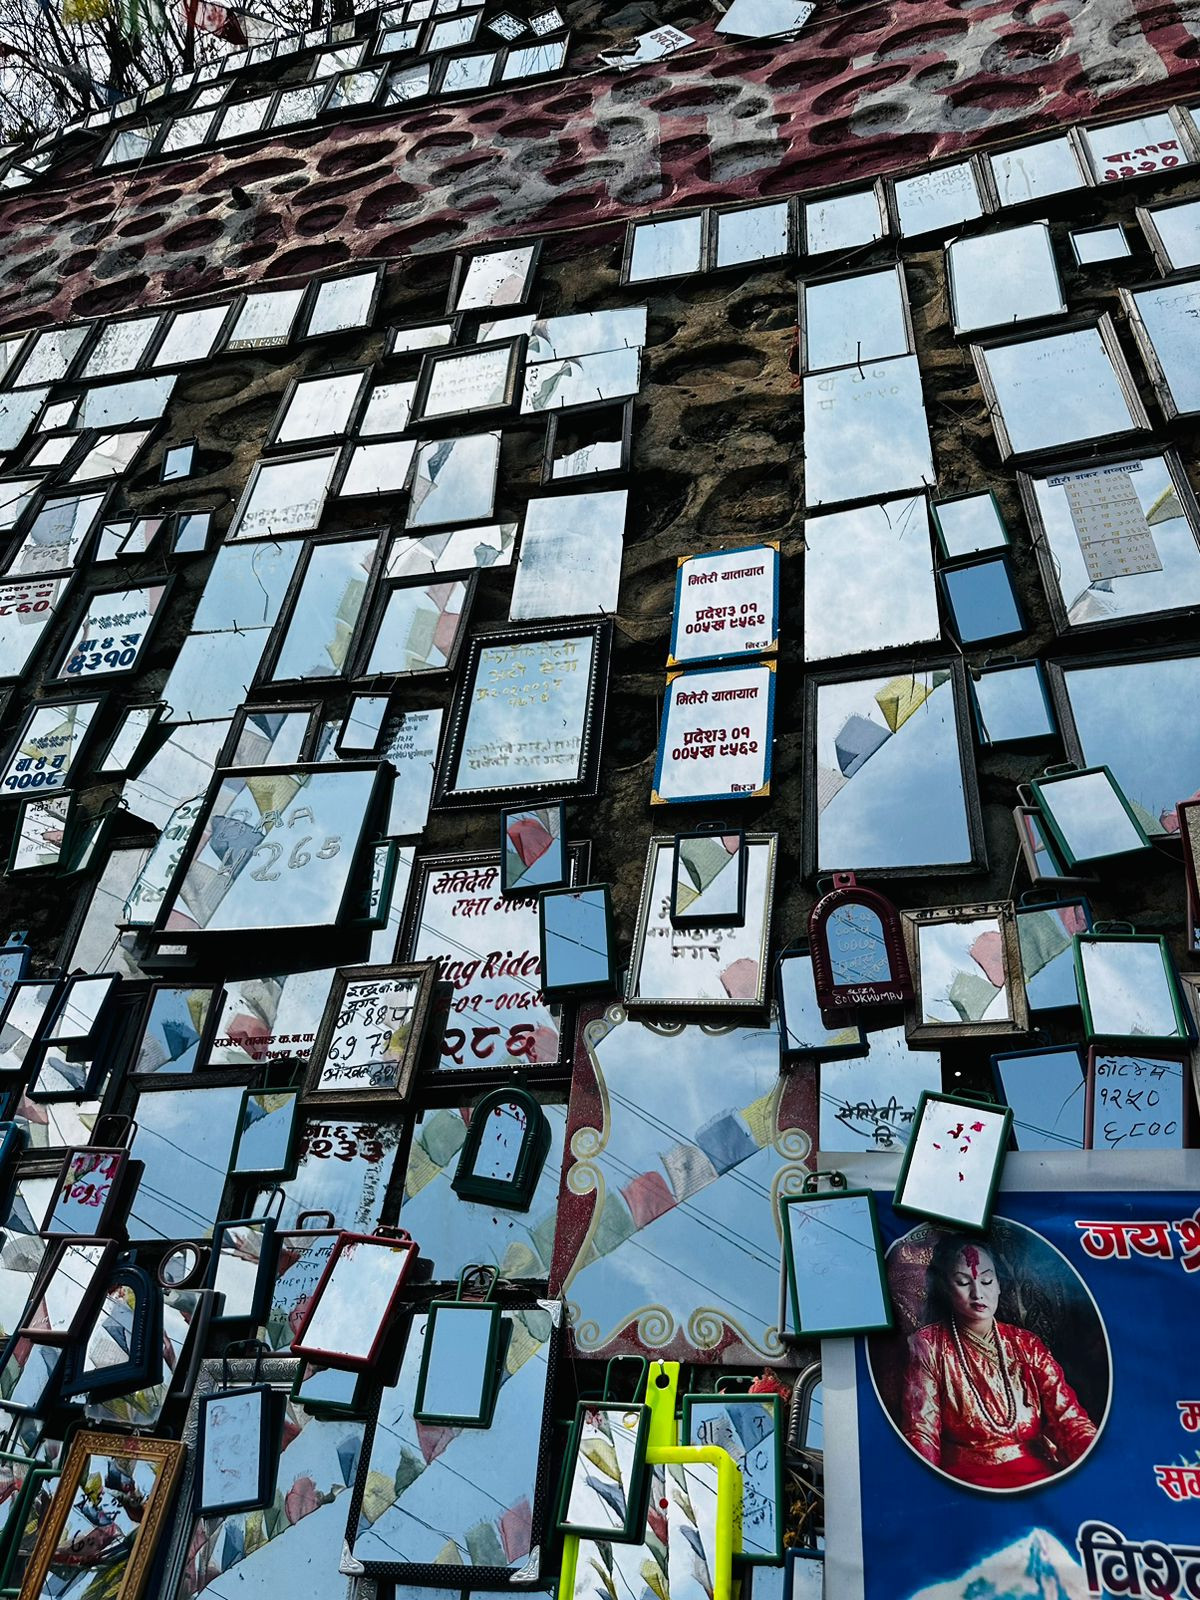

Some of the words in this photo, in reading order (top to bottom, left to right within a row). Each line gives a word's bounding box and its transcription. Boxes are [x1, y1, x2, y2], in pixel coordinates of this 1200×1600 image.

[688, 571, 718, 586] मितेरी
[721, 566, 765, 580] यातायात
[676, 689, 709, 705] मितेरी
[711, 687, 759, 702] यातायात
[1074, 1220, 1175, 1260] जय
